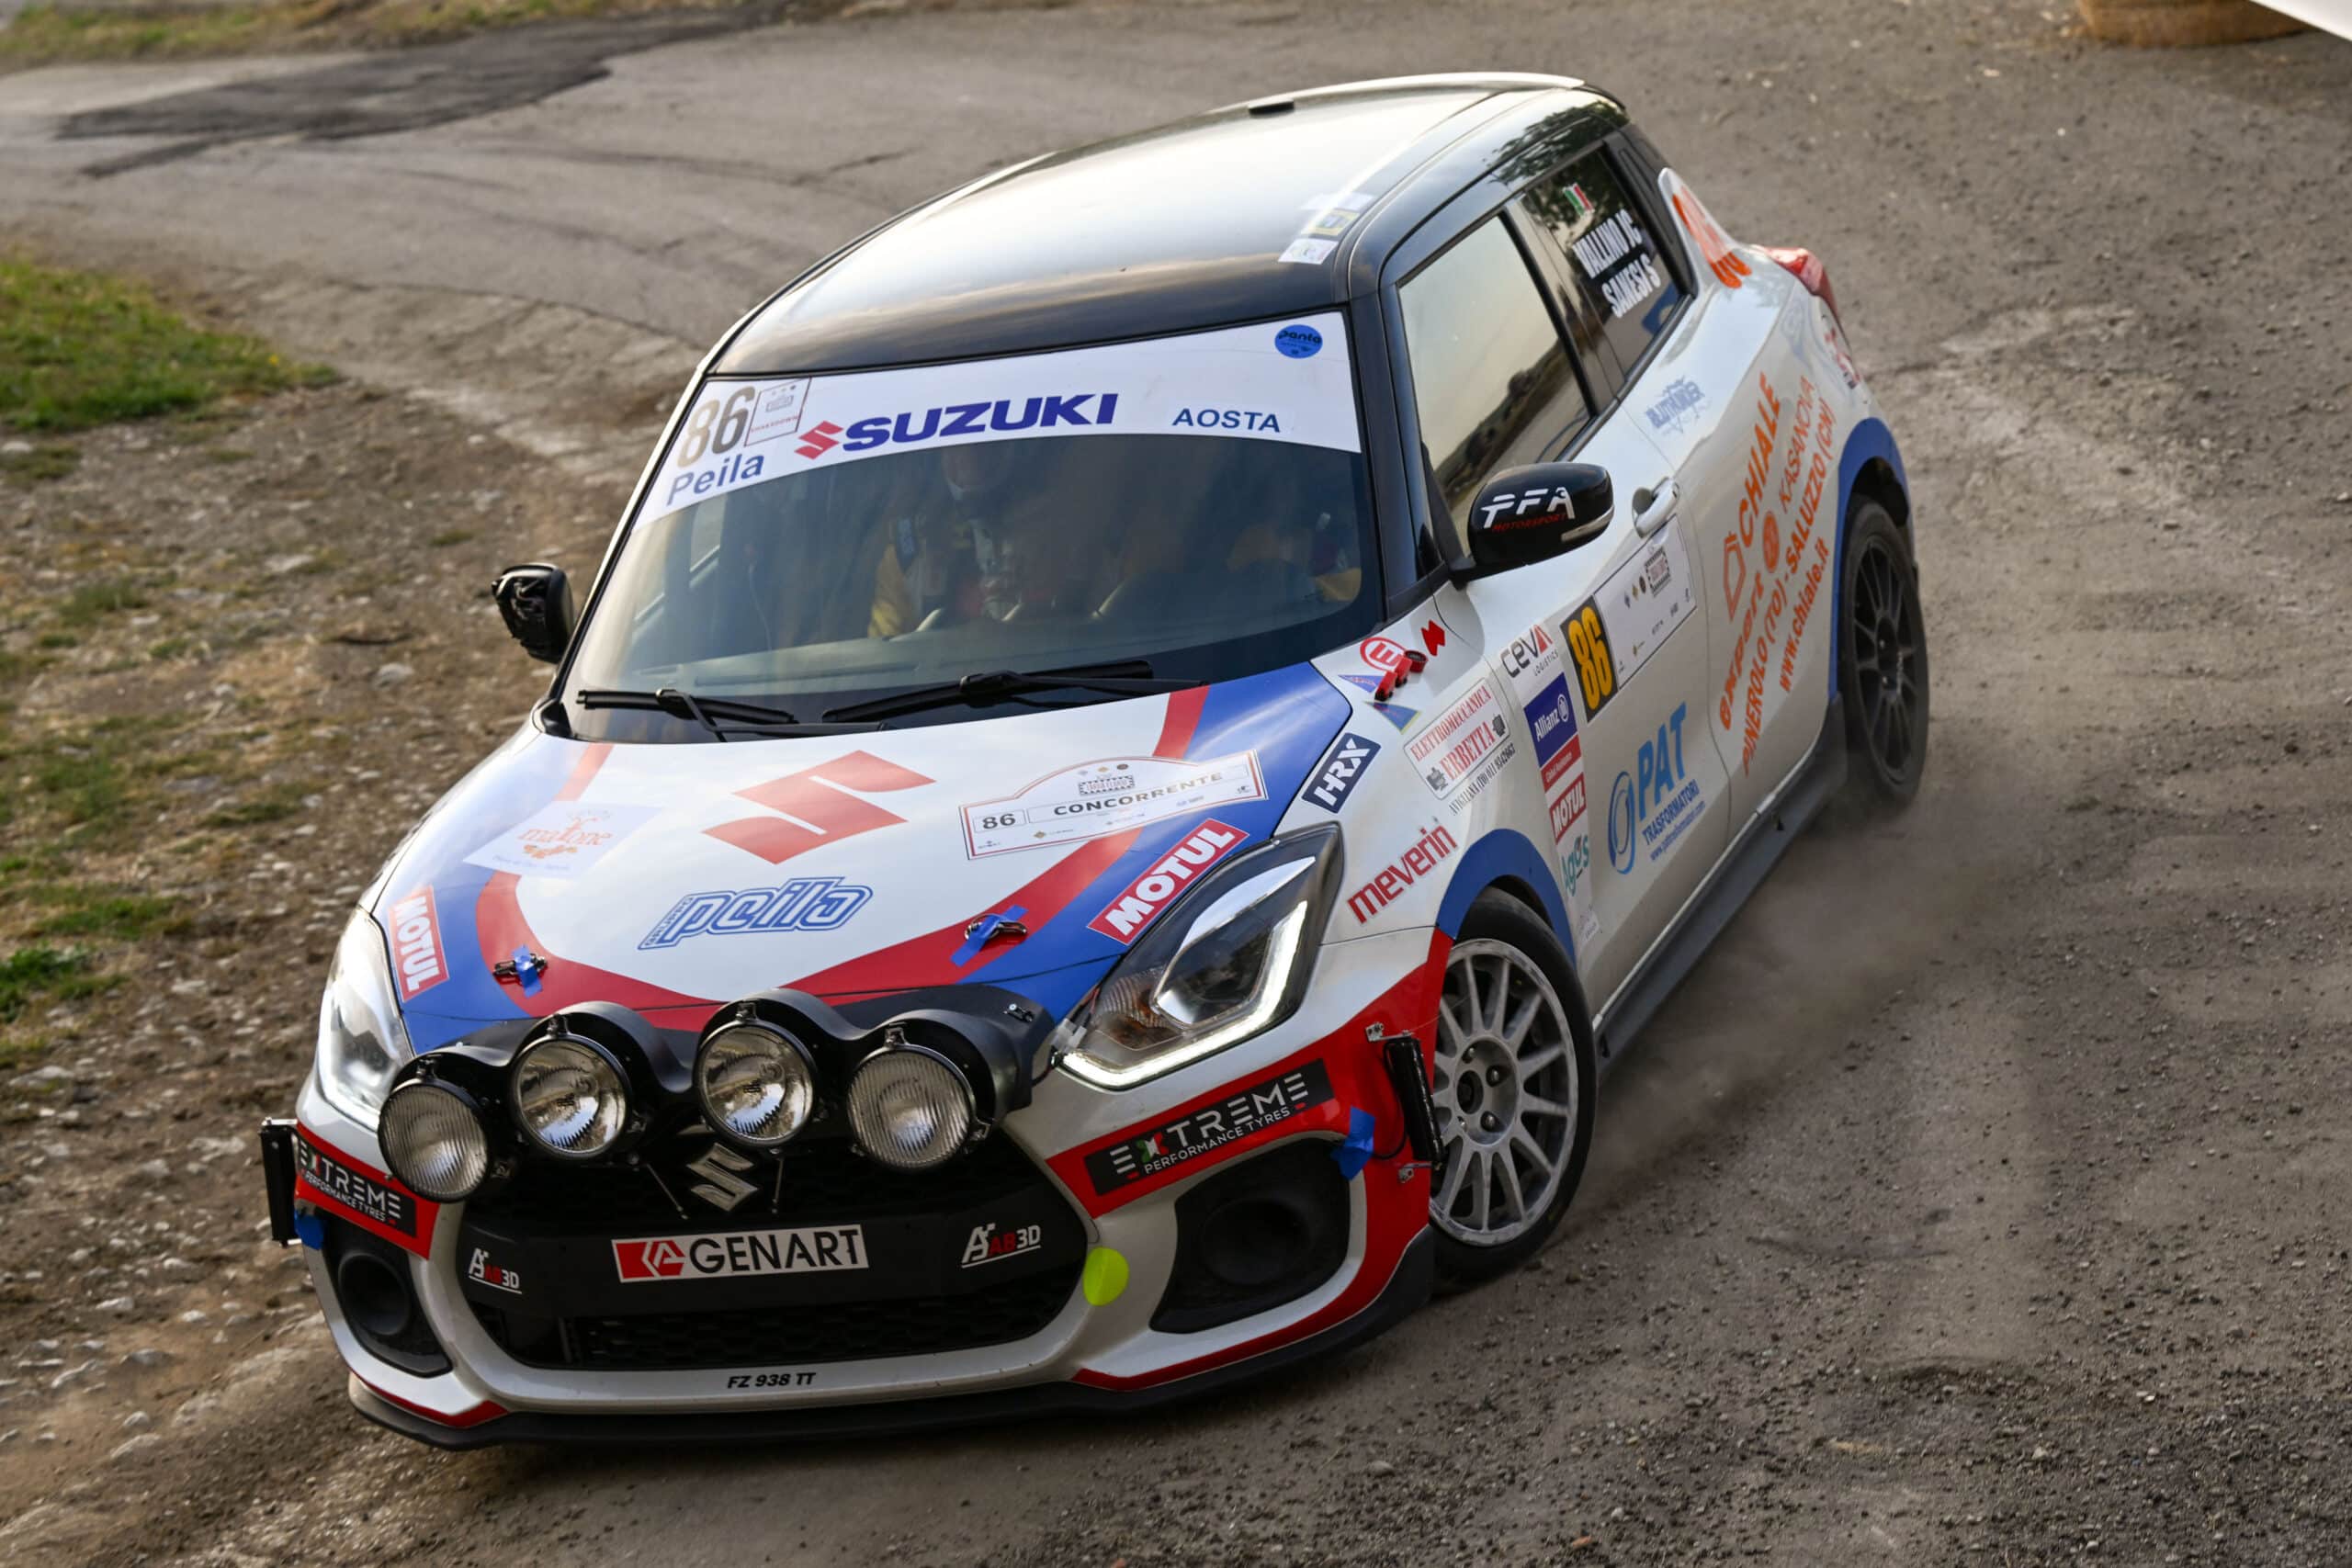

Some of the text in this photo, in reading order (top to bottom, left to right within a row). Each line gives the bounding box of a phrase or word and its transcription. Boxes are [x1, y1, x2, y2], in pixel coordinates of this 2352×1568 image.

[1601, 254, 1661, 318] SANESI S
[677, 386, 756, 468] 86
[842, 393, 1118, 451] SUZUKI
[1172, 408, 1281, 433] AOSTA
[666, 454, 765, 506] Peila
[1738, 371, 1781, 548] CHIALE
[1742, 637, 1769, 777] PINEROLO
[1785, 452, 1826, 574] SALUZZO
[1567, 605, 1613, 711] 86
[1409, 685, 1493, 763] ELETTROMECCANICA
[1439, 720, 1497, 781] ERBETTA
[1533, 707, 1561, 742] Allianz
[1314, 738, 1371, 806] HRX
[1637, 700, 1688, 823] PAT
[982, 813, 1016, 830] 86
[1054, 772, 1223, 816] CONCORRENTE
[1552, 779, 1585, 841] MOTUL
[1642, 778, 1700, 846] TRASFORMATORI
[1105, 828, 1236, 936] MOTUL
[1347, 825, 1459, 925] meverin
[1561, 835, 1589, 897] Agos
[395, 896, 440, 992] MOTUL
[1109, 1072, 1309, 1175] EXTREME
[1144, 1106, 1292, 1175] PERFORMANCE TYRES
[304, 1169, 387, 1223] PERFORMANCE TYRES
[689, 1229, 859, 1274] GENART
[727, 1372, 817, 1389] FZ 938 TT
